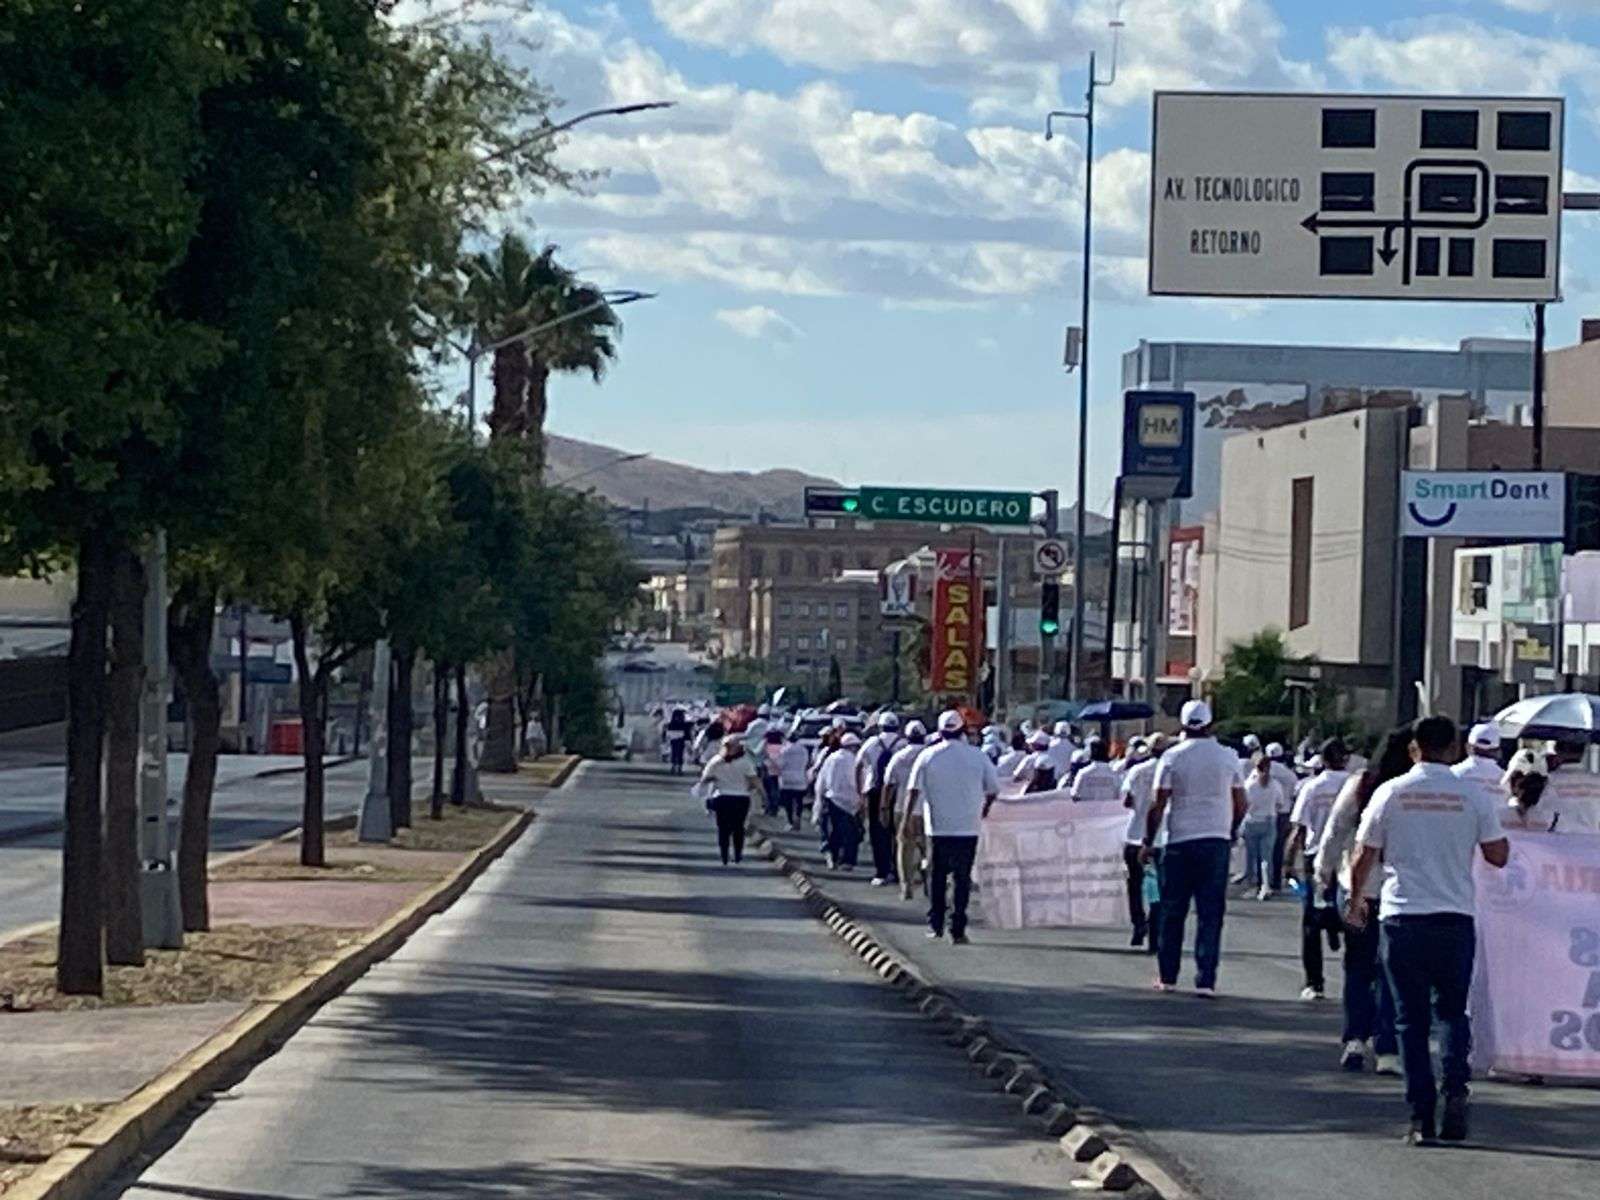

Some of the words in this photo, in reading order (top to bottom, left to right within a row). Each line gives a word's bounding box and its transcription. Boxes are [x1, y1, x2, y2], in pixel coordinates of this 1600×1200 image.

[1164, 177, 1187, 200] AV.
[1195, 177, 1300, 202] TECNOLOGICO
[1190, 229, 1261, 254] RETORNO
[1143, 417, 1178, 434] HM
[1415, 478, 1550, 500] SmartDent
[897, 496, 1021, 517] ESCUDERO
[944, 584, 970, 689] SALAS
